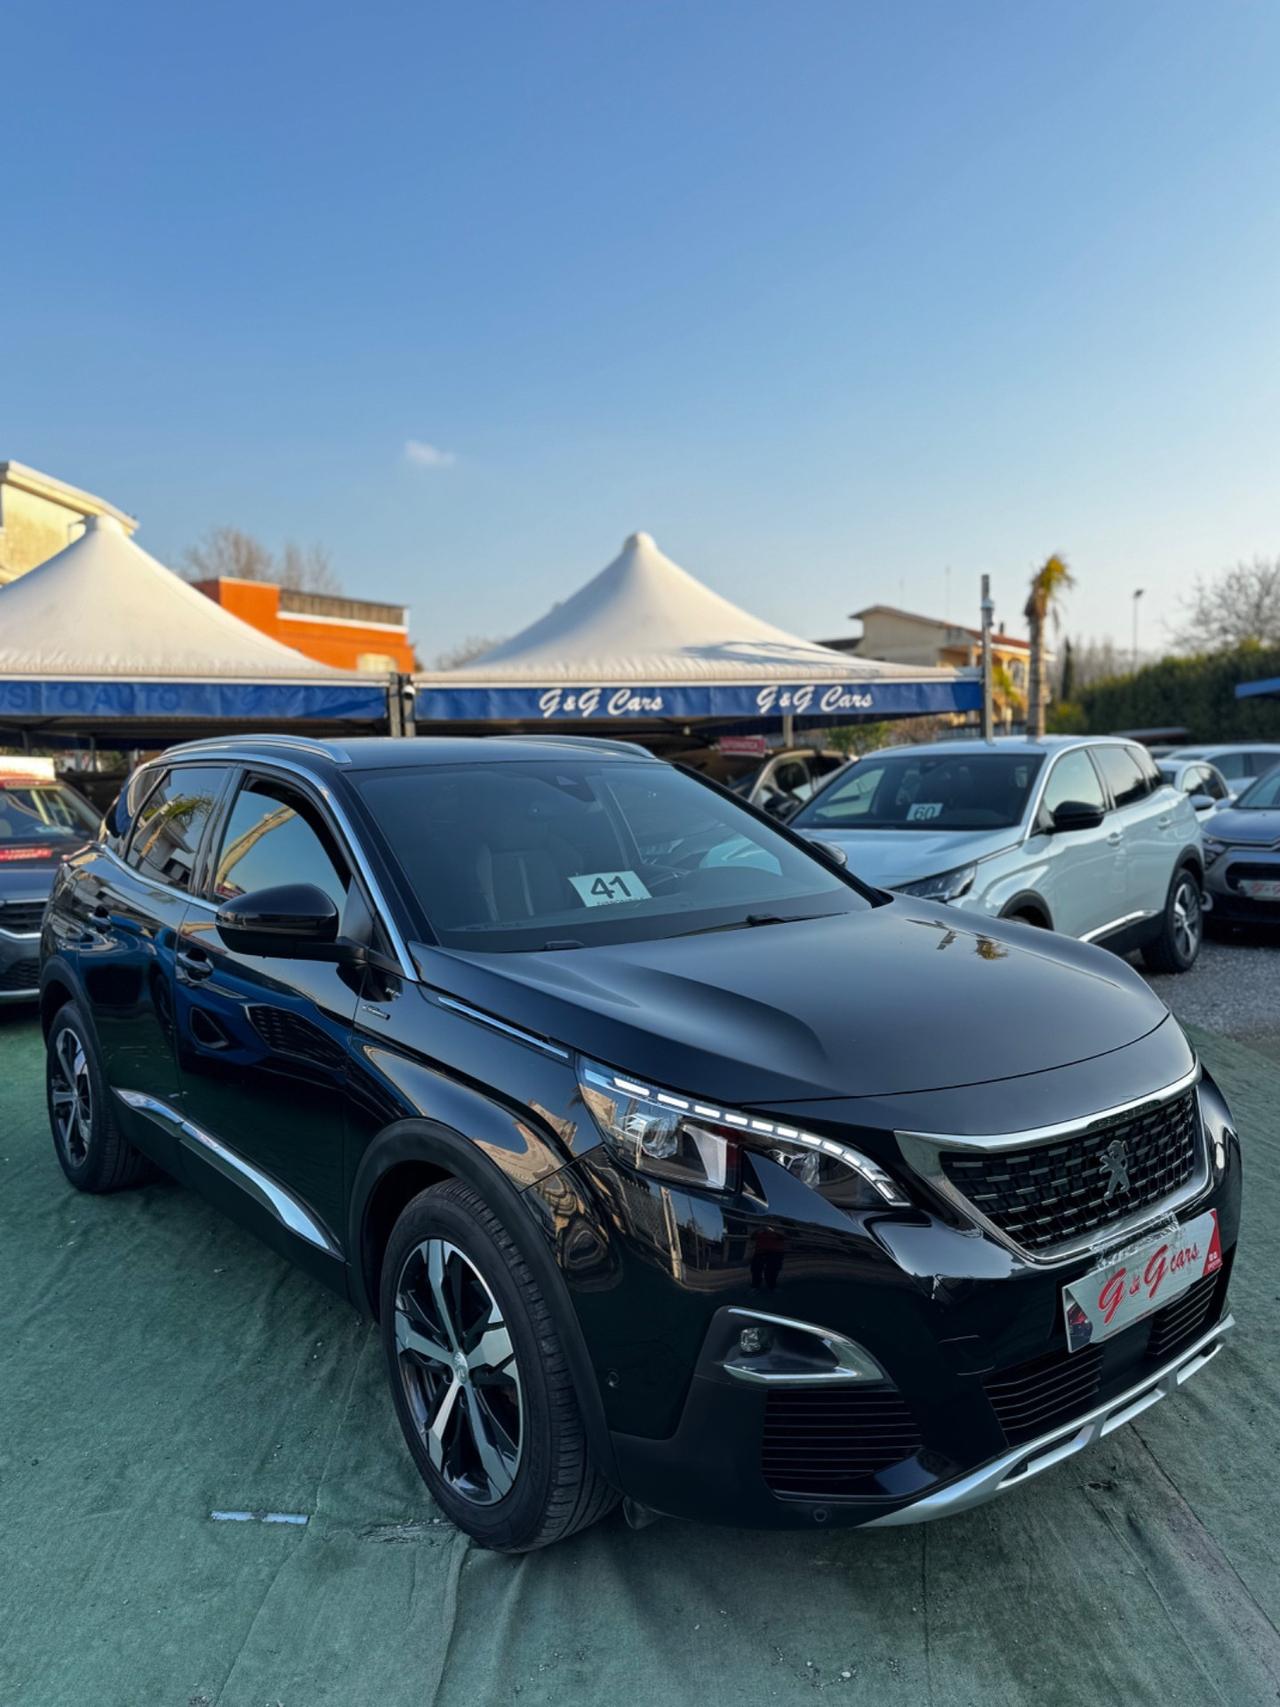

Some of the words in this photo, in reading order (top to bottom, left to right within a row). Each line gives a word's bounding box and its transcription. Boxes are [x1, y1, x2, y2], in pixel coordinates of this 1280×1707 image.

[539, 688, 601, 718] G&G
[608, 688, 663, 715] Cars
[757, 686, 815, 714] G&G
[821, 685, 873, 711] Cars
[914, 806, 936, 820] 60
[591, 876, 632, 899] 41
